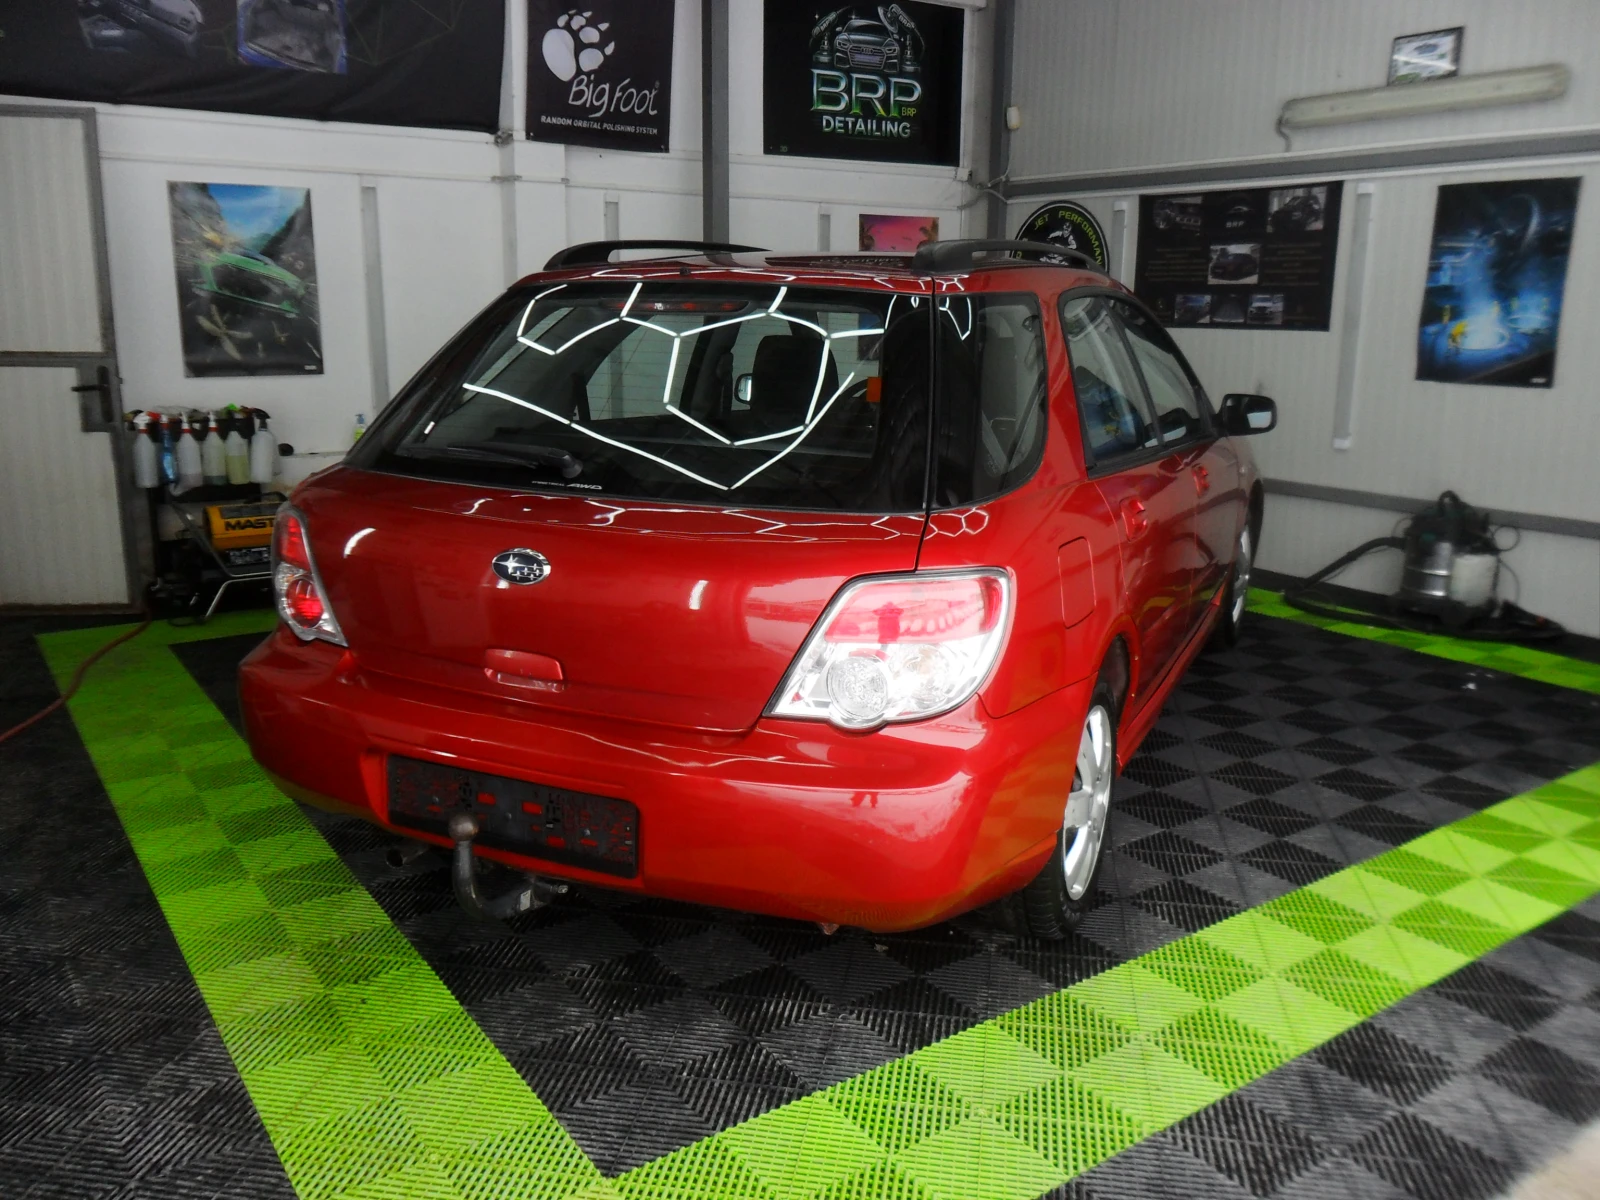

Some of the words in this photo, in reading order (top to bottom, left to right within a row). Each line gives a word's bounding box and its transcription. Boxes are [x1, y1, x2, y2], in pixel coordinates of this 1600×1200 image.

[810, 68, 922, 117] BRP
[901, 107, 917, 116] BRP
[540, 115, 573, 126] RANDOM
[573, 119, 601, 129] ORBITAL
[602, 122, 635, 133] POLISHING
[635, 126, 658, 135] SYSTEM
[822, 115, 911, 138] DETAILING
[1034, 213, 1050, 230] JET
